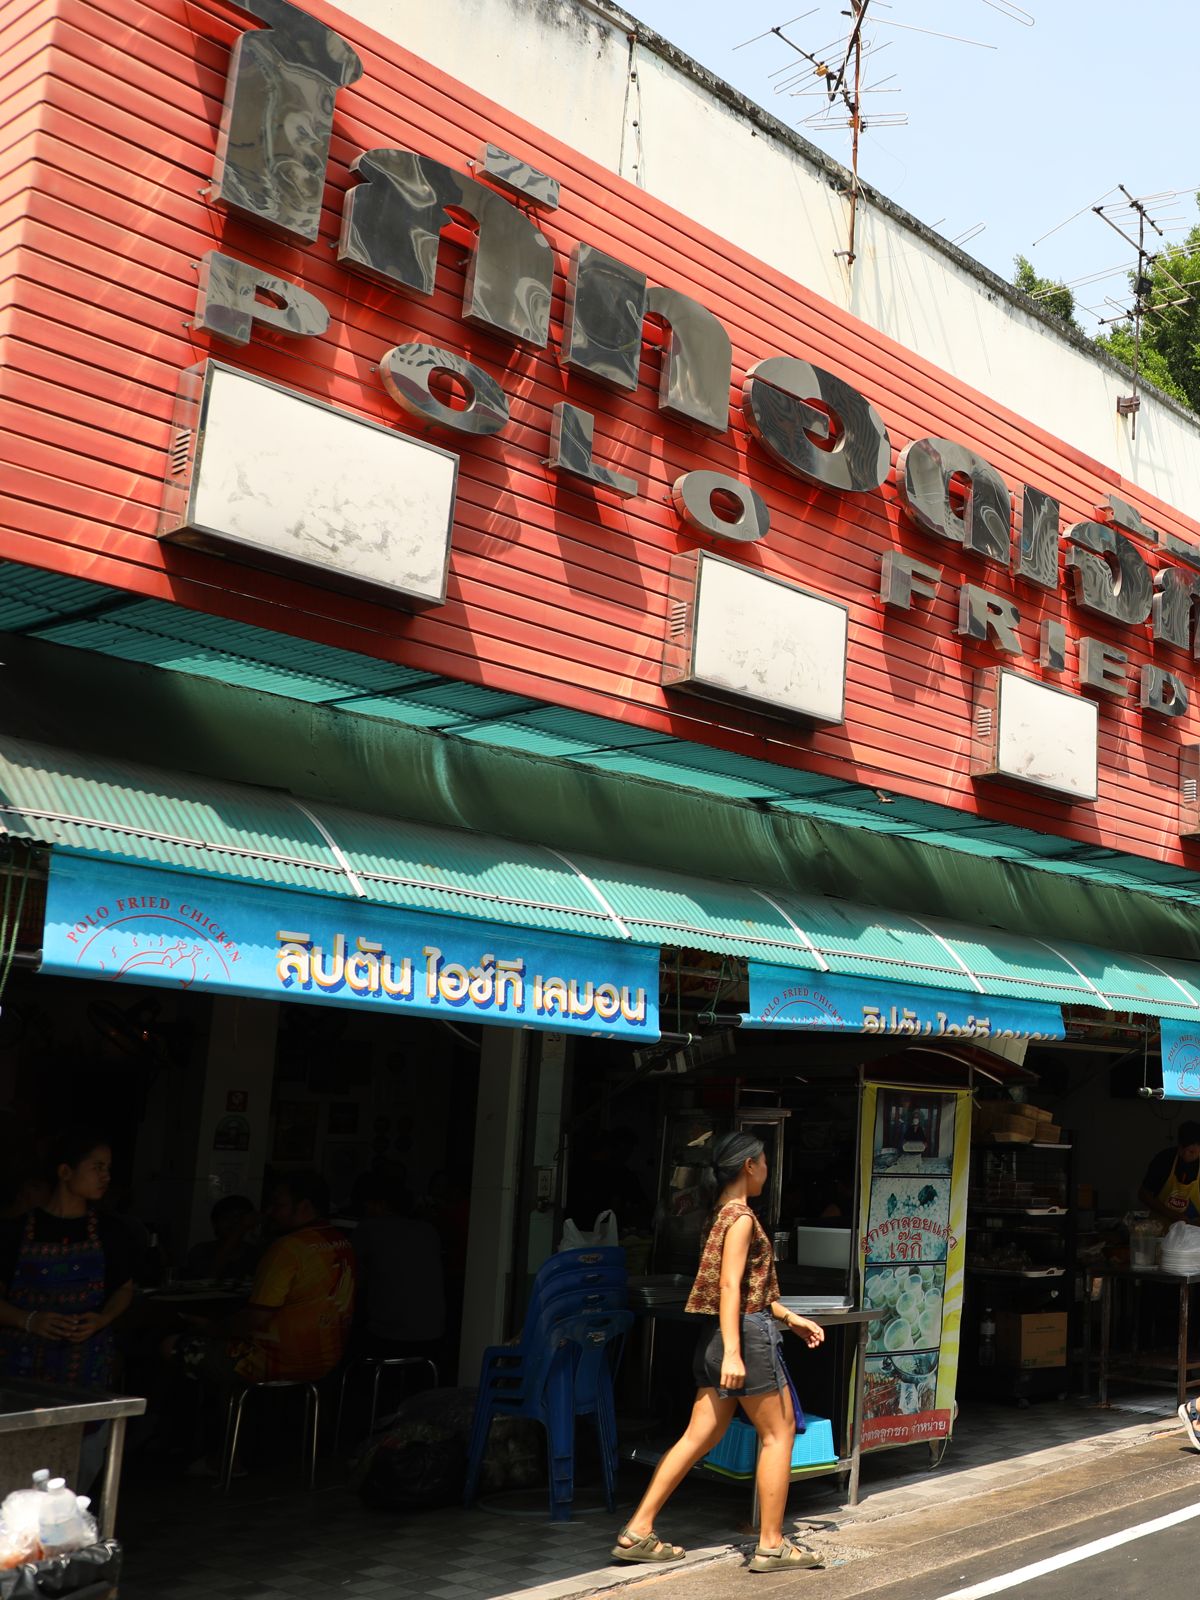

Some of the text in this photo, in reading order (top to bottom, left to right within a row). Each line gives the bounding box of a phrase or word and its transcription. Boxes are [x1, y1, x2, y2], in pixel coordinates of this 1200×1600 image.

[193, 250, 770, 543] POLO
[880, 550, 1188, 717] FRIED
[66, 896, 242, 964] POLO FRIED CHICKEN
[276, 930, 648, 1025] ลิปตัน ไอซ์ที เลมอน
[782, 986, 809, 999] FRIED
